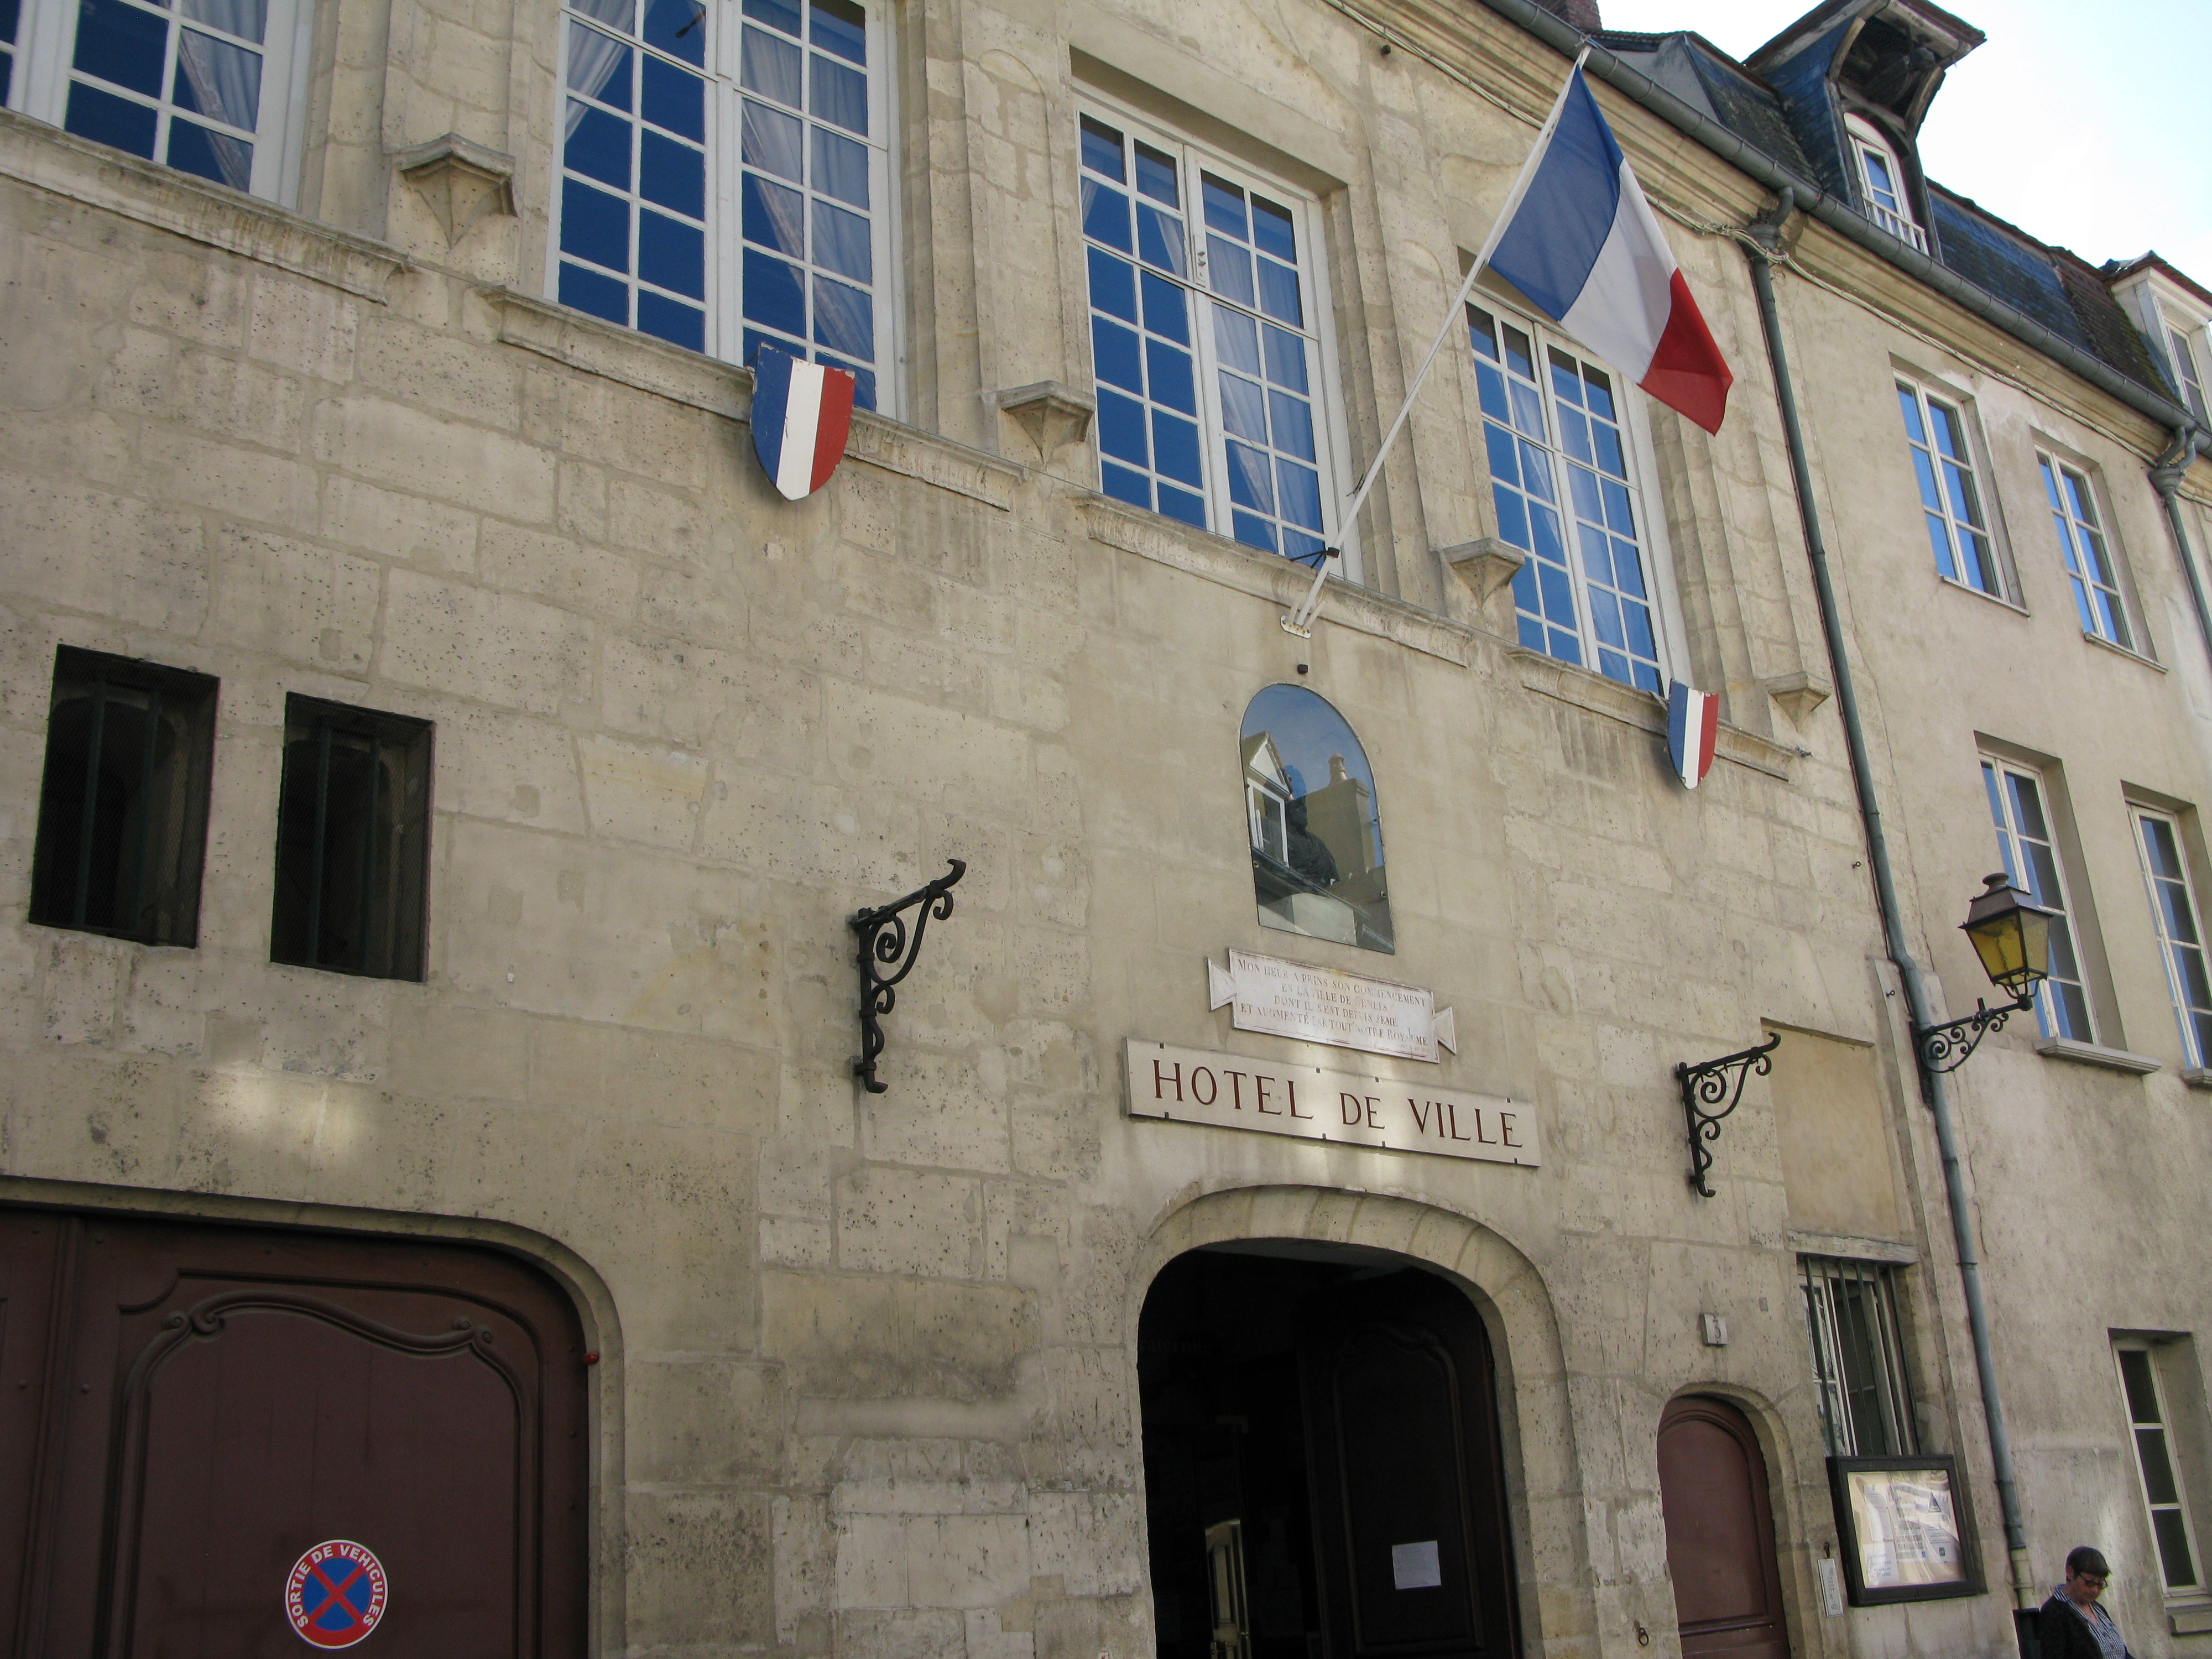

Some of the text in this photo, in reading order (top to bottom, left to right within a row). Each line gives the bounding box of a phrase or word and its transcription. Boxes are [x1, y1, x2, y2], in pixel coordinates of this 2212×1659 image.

[1238, 959, 1260, 972] MON
[1293, 972, 1300, 982] A
[1302, 973, 1328, 987] PRINS
[1332, 980, 1351, 991] SON
[1354, 984, 1426, 1006] COMMENCEMENT
[1282, 983, 1387, 1011] EN LA VILLE DE SENLIS
[1241, 1003, 1253, 1014] ET
[1256, 1006, 1310, 1024] AUGMENTÉ
[1387, 1028, 1428, 1046] ROYAUME
[1274, 995, 1301, 1009] DONT
[1305, 1001, 1313, 1011] IL
[1343, 1008, 1373, 1022] DEPUIS
[1152, 1059, 1524, 1148] HOTEL DE VILLE
[1712, 1319, 1721, 1338] 3
[290, 1544, 384, 1628] SORTIE DE VEHICULES
